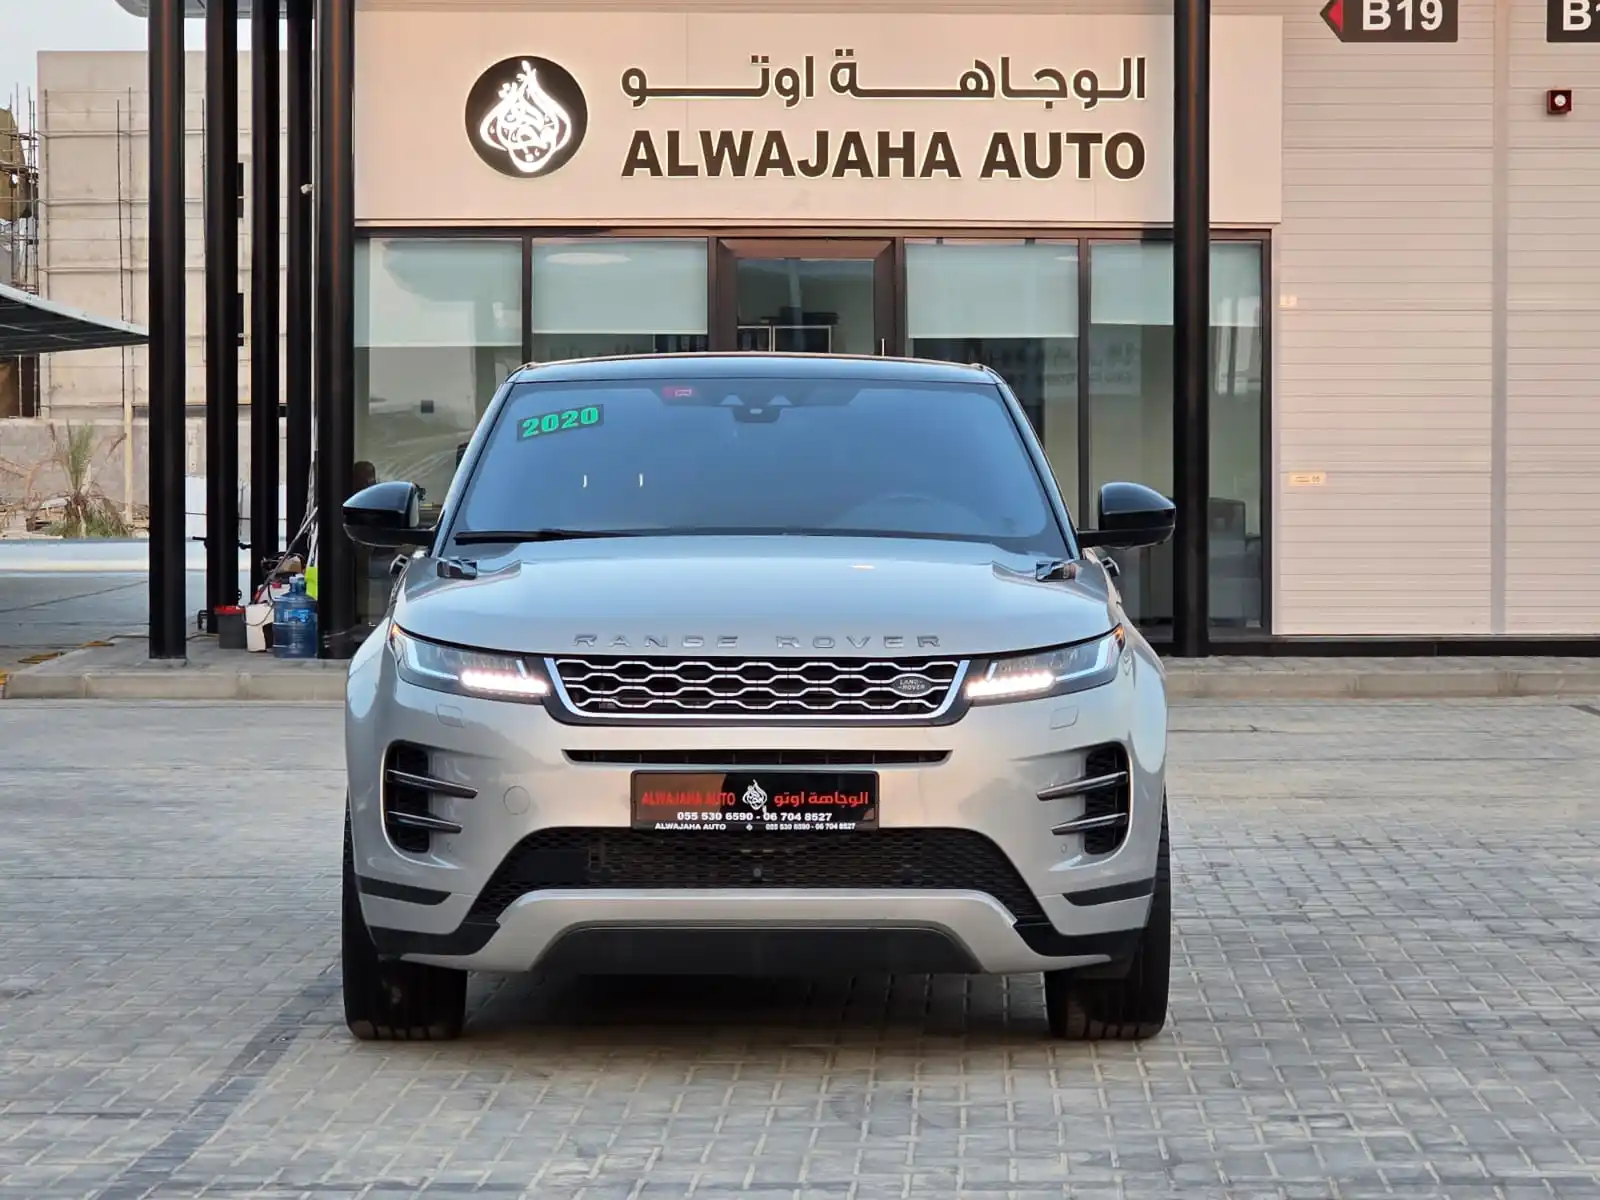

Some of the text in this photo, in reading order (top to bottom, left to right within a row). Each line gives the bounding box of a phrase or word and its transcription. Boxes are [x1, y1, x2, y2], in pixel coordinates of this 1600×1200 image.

[1362, 0, 1443, 31] B19
[621, 130, 1146, 181] ALWAJAHA AUTO
[521, 406, 599, 438] 2020
[572, 633, 942, 649] RANGE ROVER
[642, 791, 703, 806] ALWAJAHA
[705, 792, 736, 806] AUTO
[677, 812, 698, 821] 055
[701, 812, 722, 821] 530
[725, 812, 753, 821] 6590
[763, 812, 778, 821] 06
[780, 812, 802, 821] 704
[804, 812, 832, 821] 8527
[654, 822, 727, 831] ALWAJAHA AUTO
